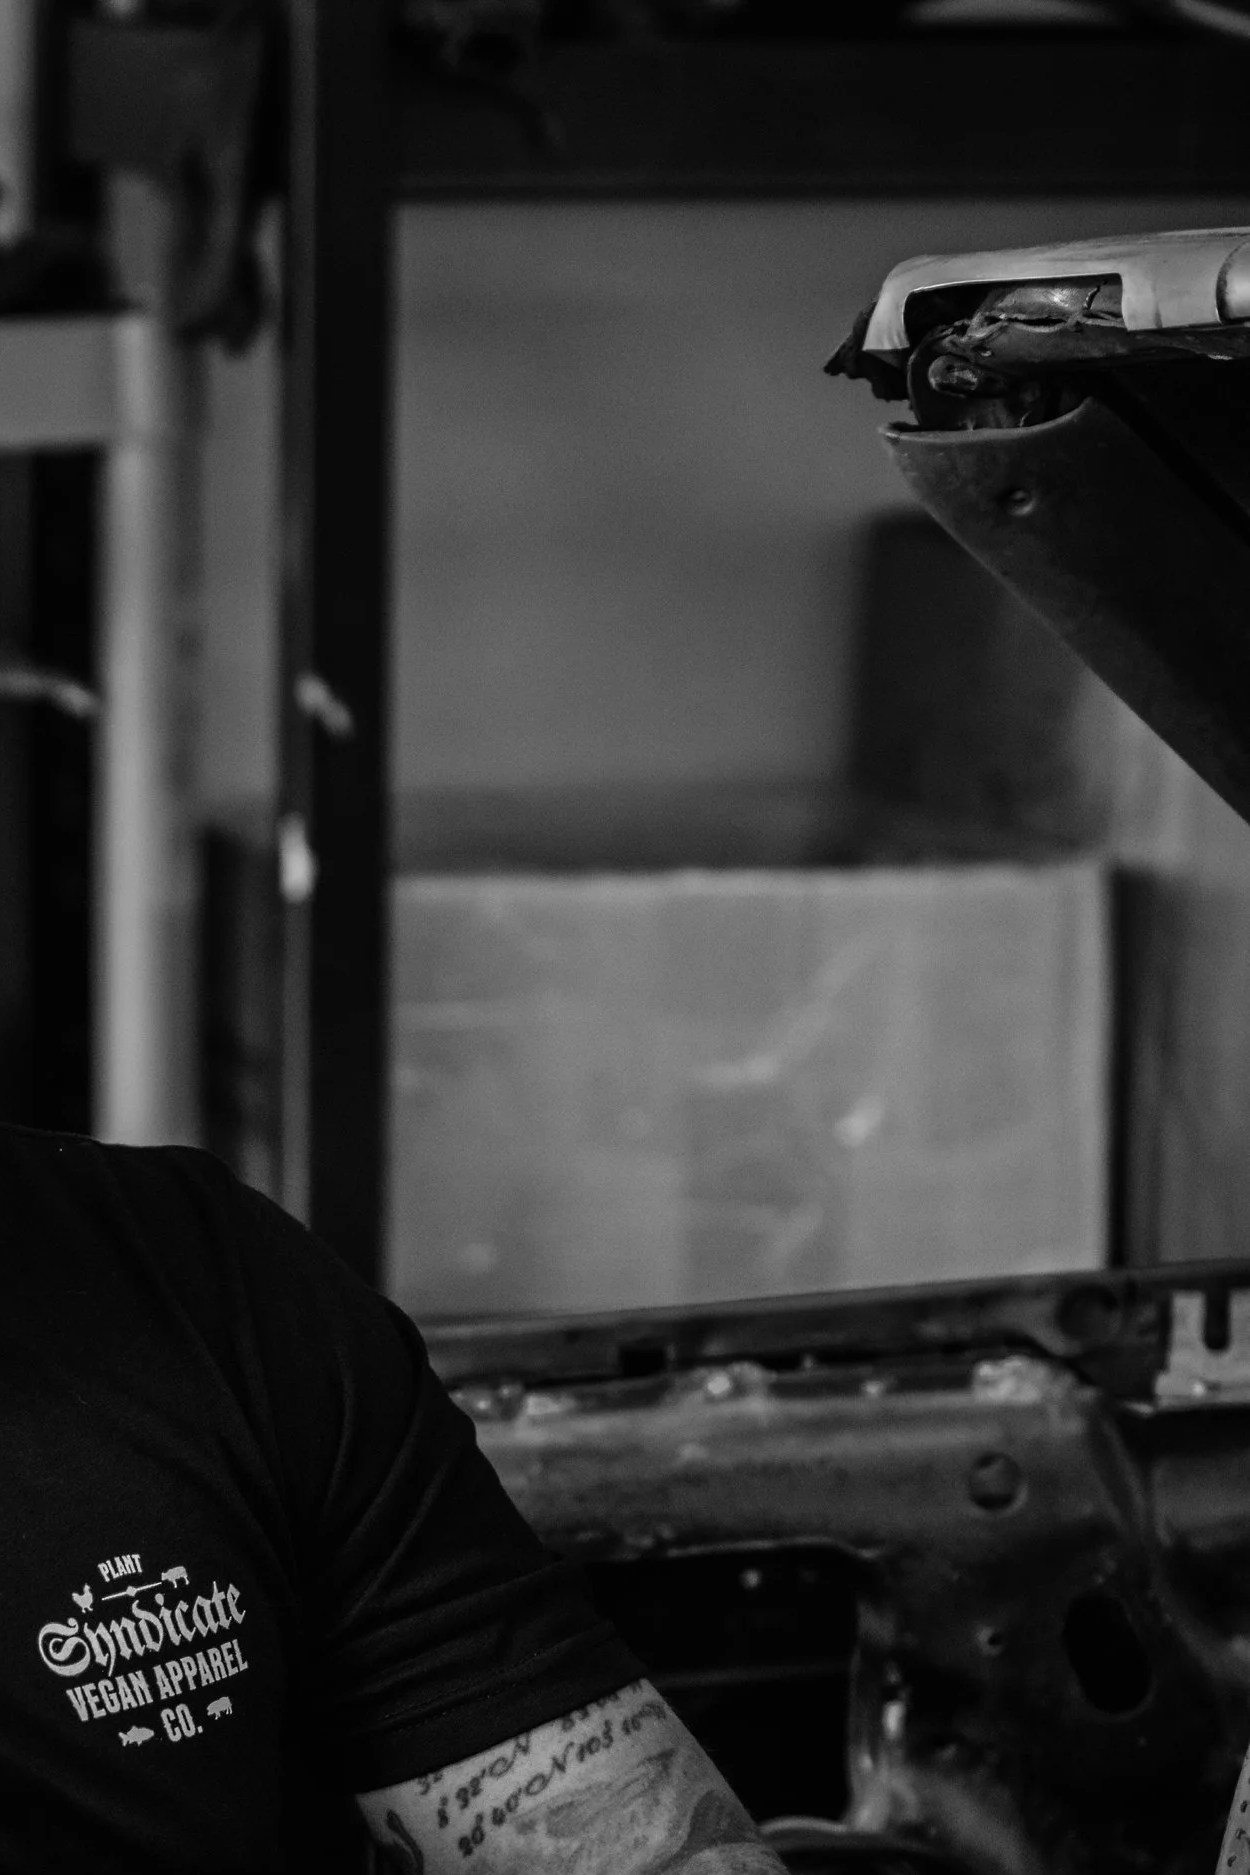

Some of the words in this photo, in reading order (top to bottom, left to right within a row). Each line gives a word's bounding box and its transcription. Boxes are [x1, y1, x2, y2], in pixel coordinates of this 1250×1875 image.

[97, 1554, 143, 1582] PLANT
[38, 1581, 246, 1677] Syndicate
[66, 1670, 153, 1722] VEGAN
[153, 1639, 248, 1700] APPAREL
[160, 1704, 203, 1742] CO.
